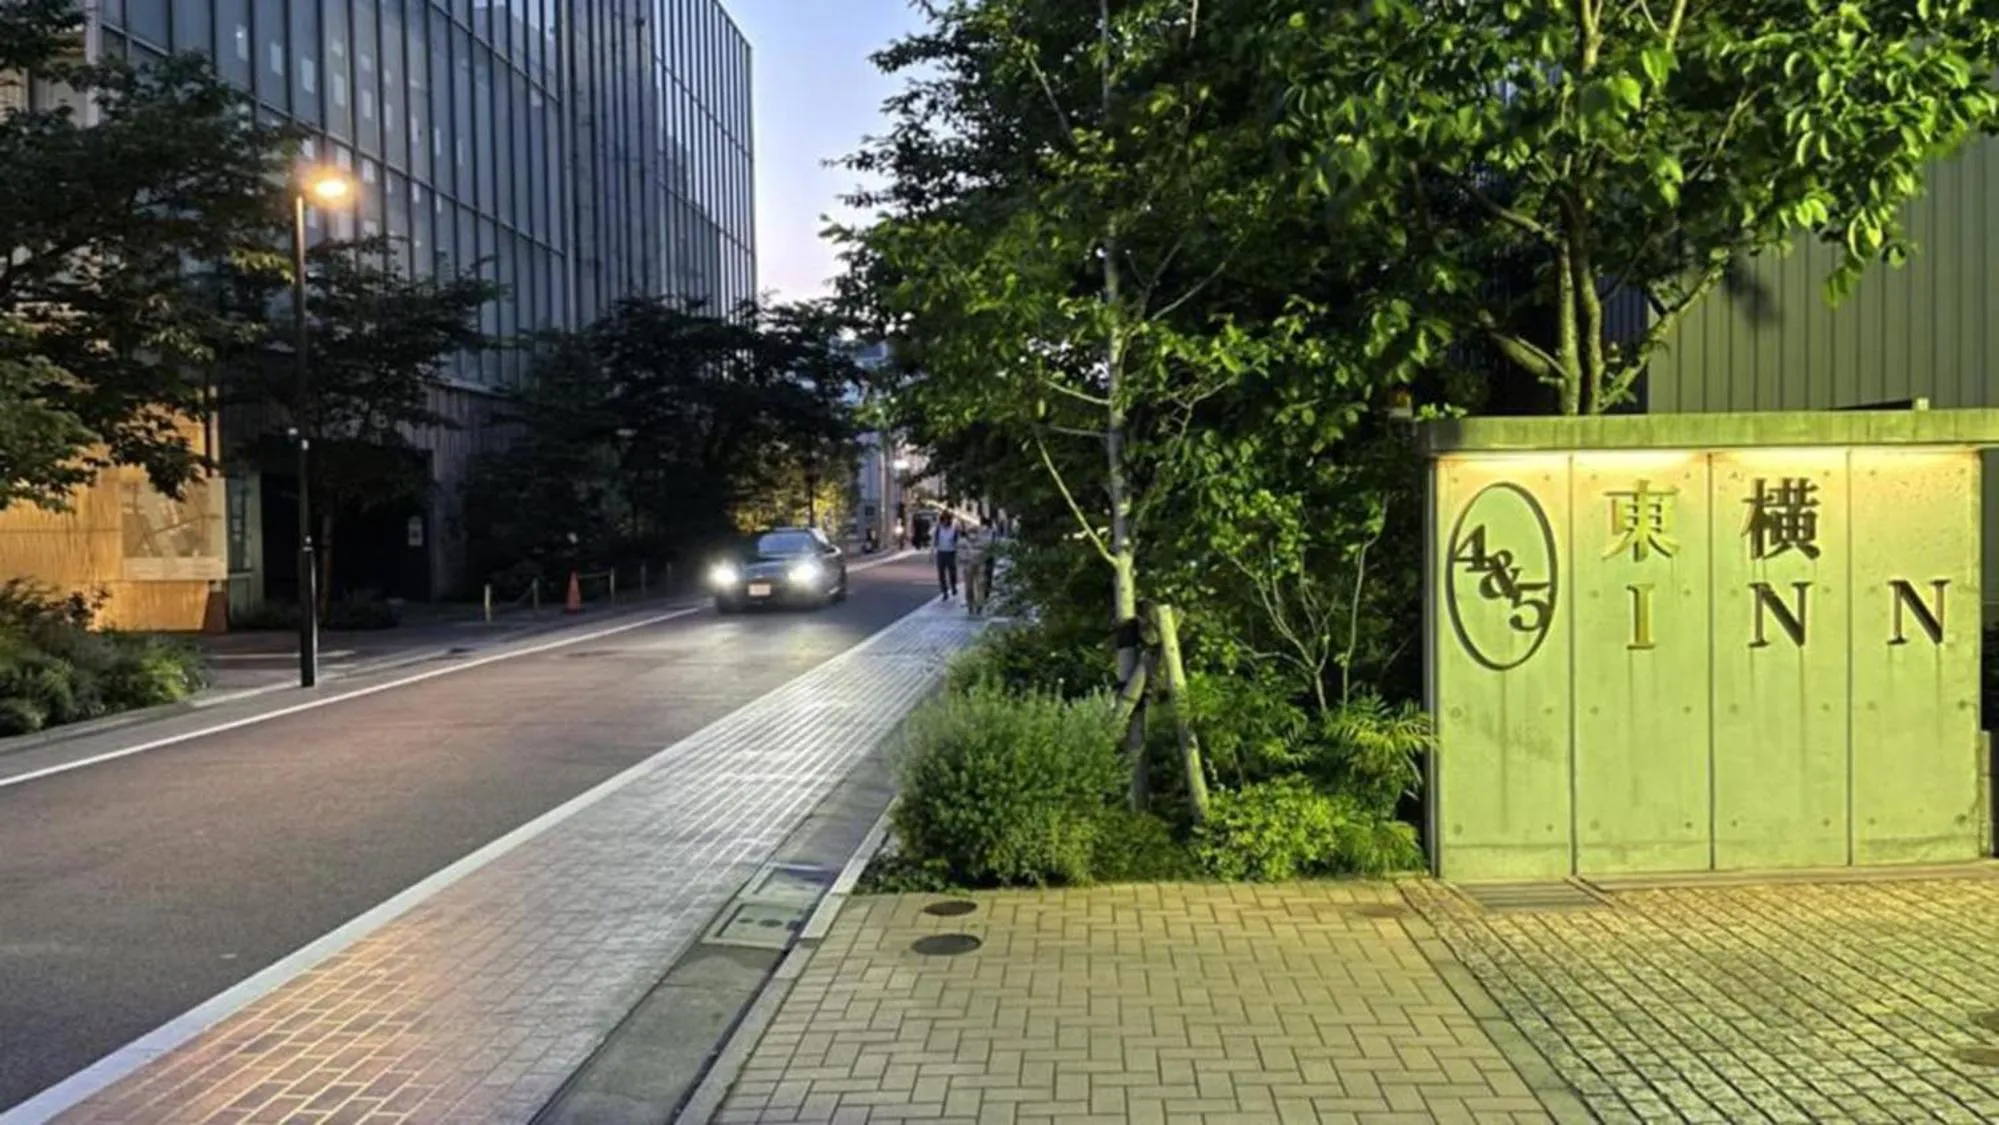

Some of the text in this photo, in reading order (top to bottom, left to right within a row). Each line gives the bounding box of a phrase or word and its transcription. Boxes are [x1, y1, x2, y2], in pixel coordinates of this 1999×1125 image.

[1602, 478, 1821, 562] 東横
[1454, 525, 1549, 631] 4&5
[1627, 579, 1950, 649] INN
